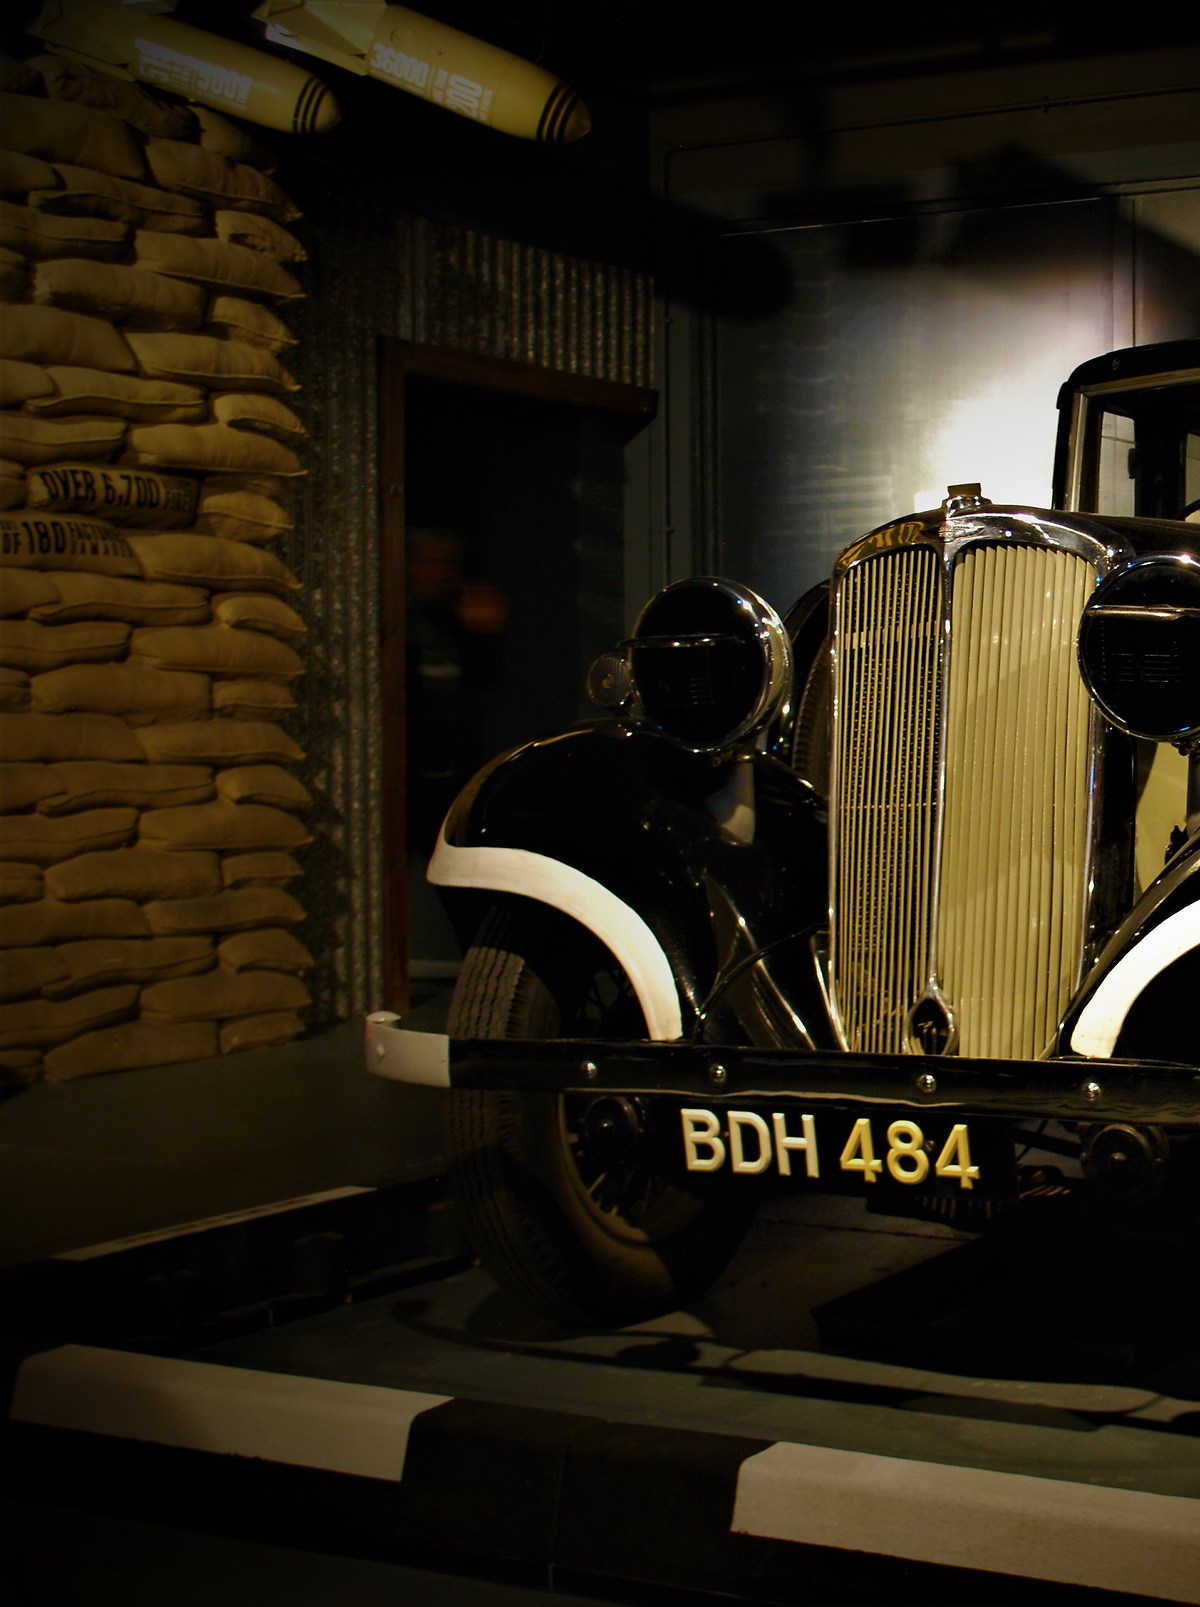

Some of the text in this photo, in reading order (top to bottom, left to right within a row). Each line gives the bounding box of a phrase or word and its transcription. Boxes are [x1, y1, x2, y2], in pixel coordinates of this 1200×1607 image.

[370, 43, 429, 88] 36000
[39, 469, 97, 503] OVER
[101, 472, 160, 508] 6,700
[22, 521, 66, 554] 180
[680, 1107, 981, 1190] BDH 484
